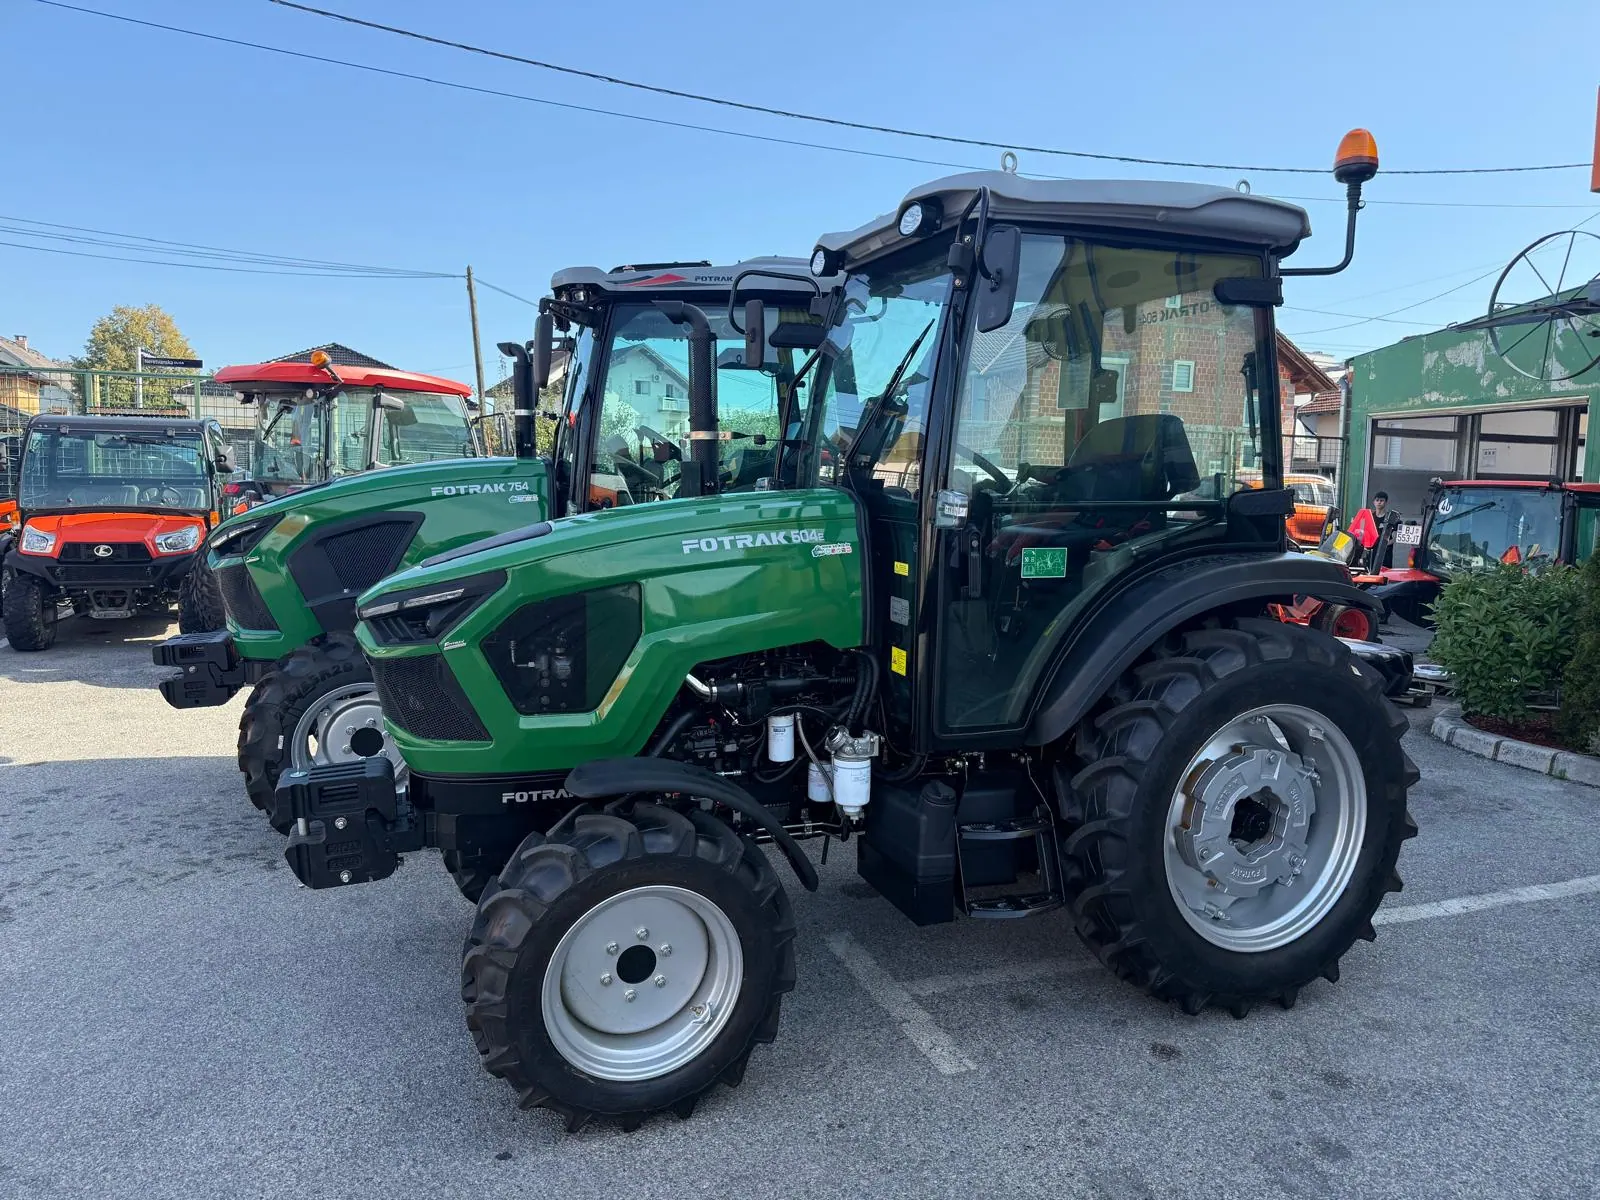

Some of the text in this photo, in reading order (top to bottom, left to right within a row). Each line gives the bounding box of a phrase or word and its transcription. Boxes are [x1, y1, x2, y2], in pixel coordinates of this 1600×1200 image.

[431, 483, 506, 496] FOTRAK
[1405, 526, 1415, 535] BJ
[681, 531, 787, 554] FOTRAK
[502, 788, 574, 804] FOTRA
